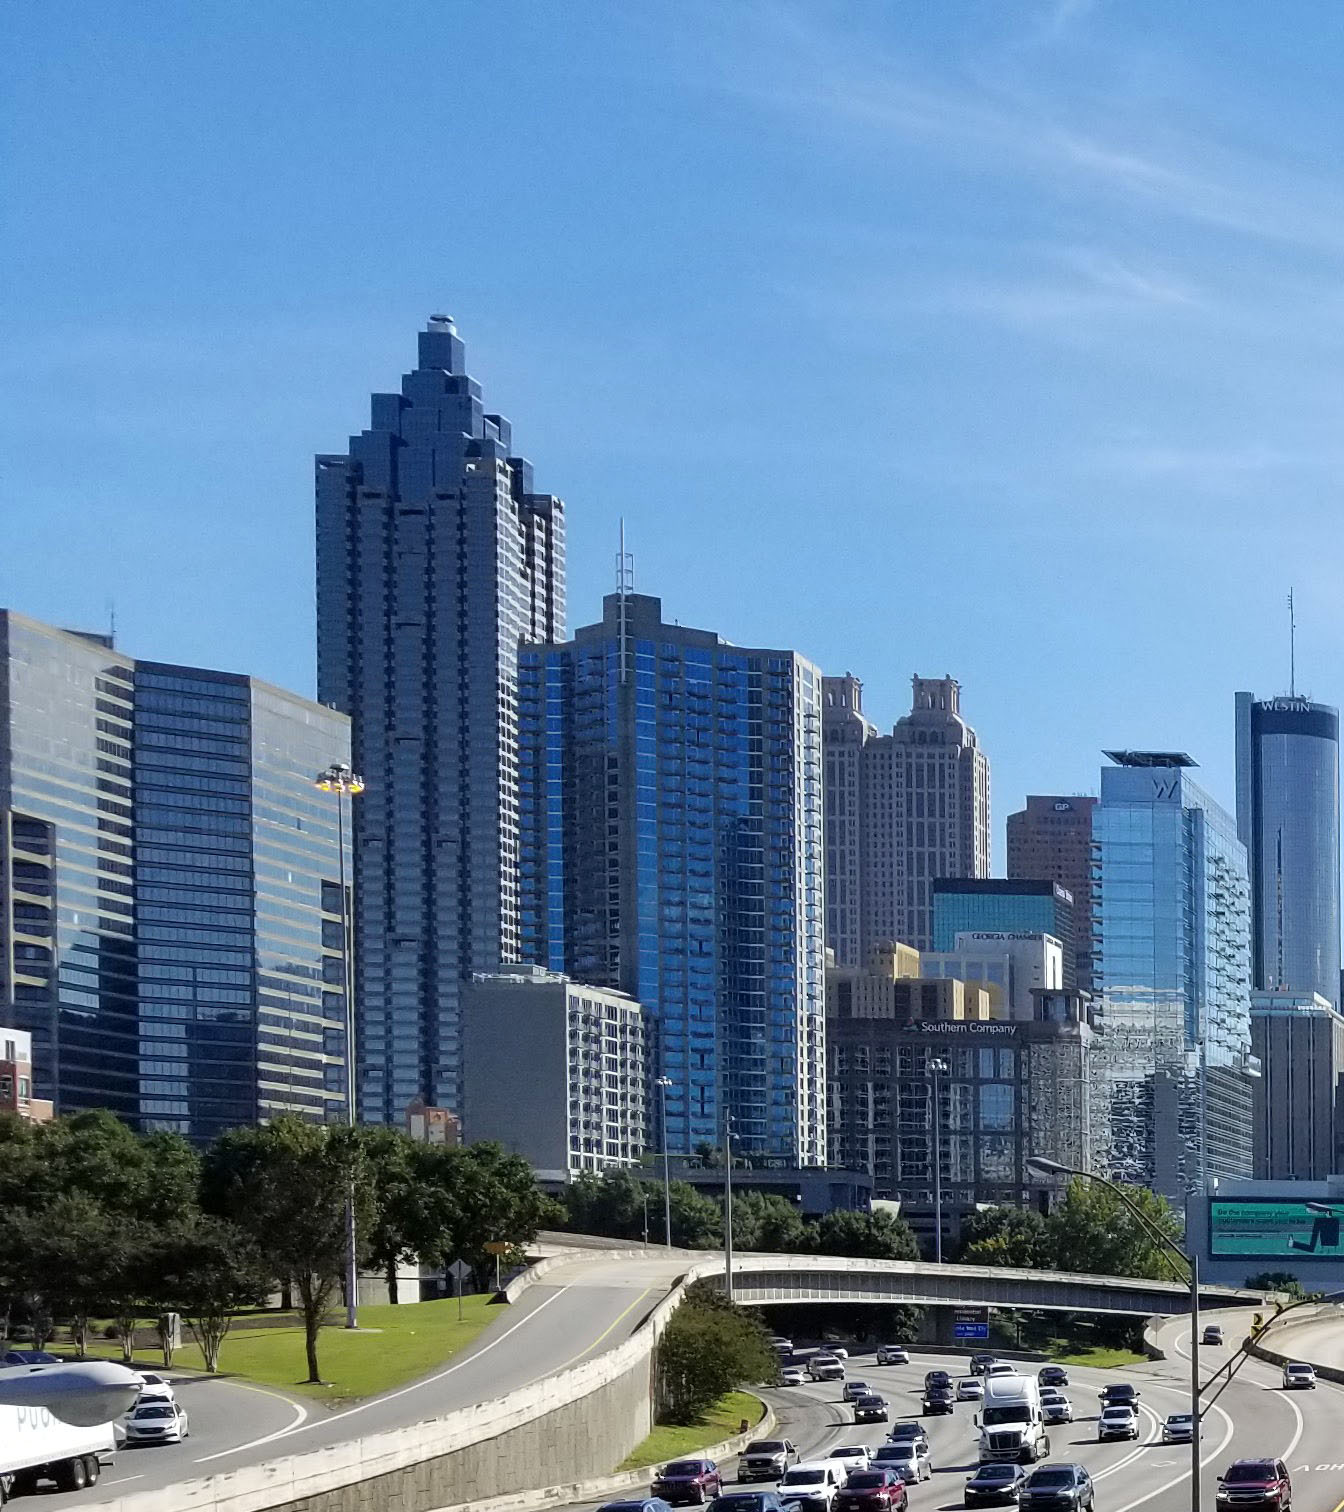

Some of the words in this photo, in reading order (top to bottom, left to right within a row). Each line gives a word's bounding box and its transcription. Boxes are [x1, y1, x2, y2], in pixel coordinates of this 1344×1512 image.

[1261, 701, 1310, 712] WESTIN
[921, 1022, 967, 1032] Southern
[969, 1022, 1017, 1035] Company
